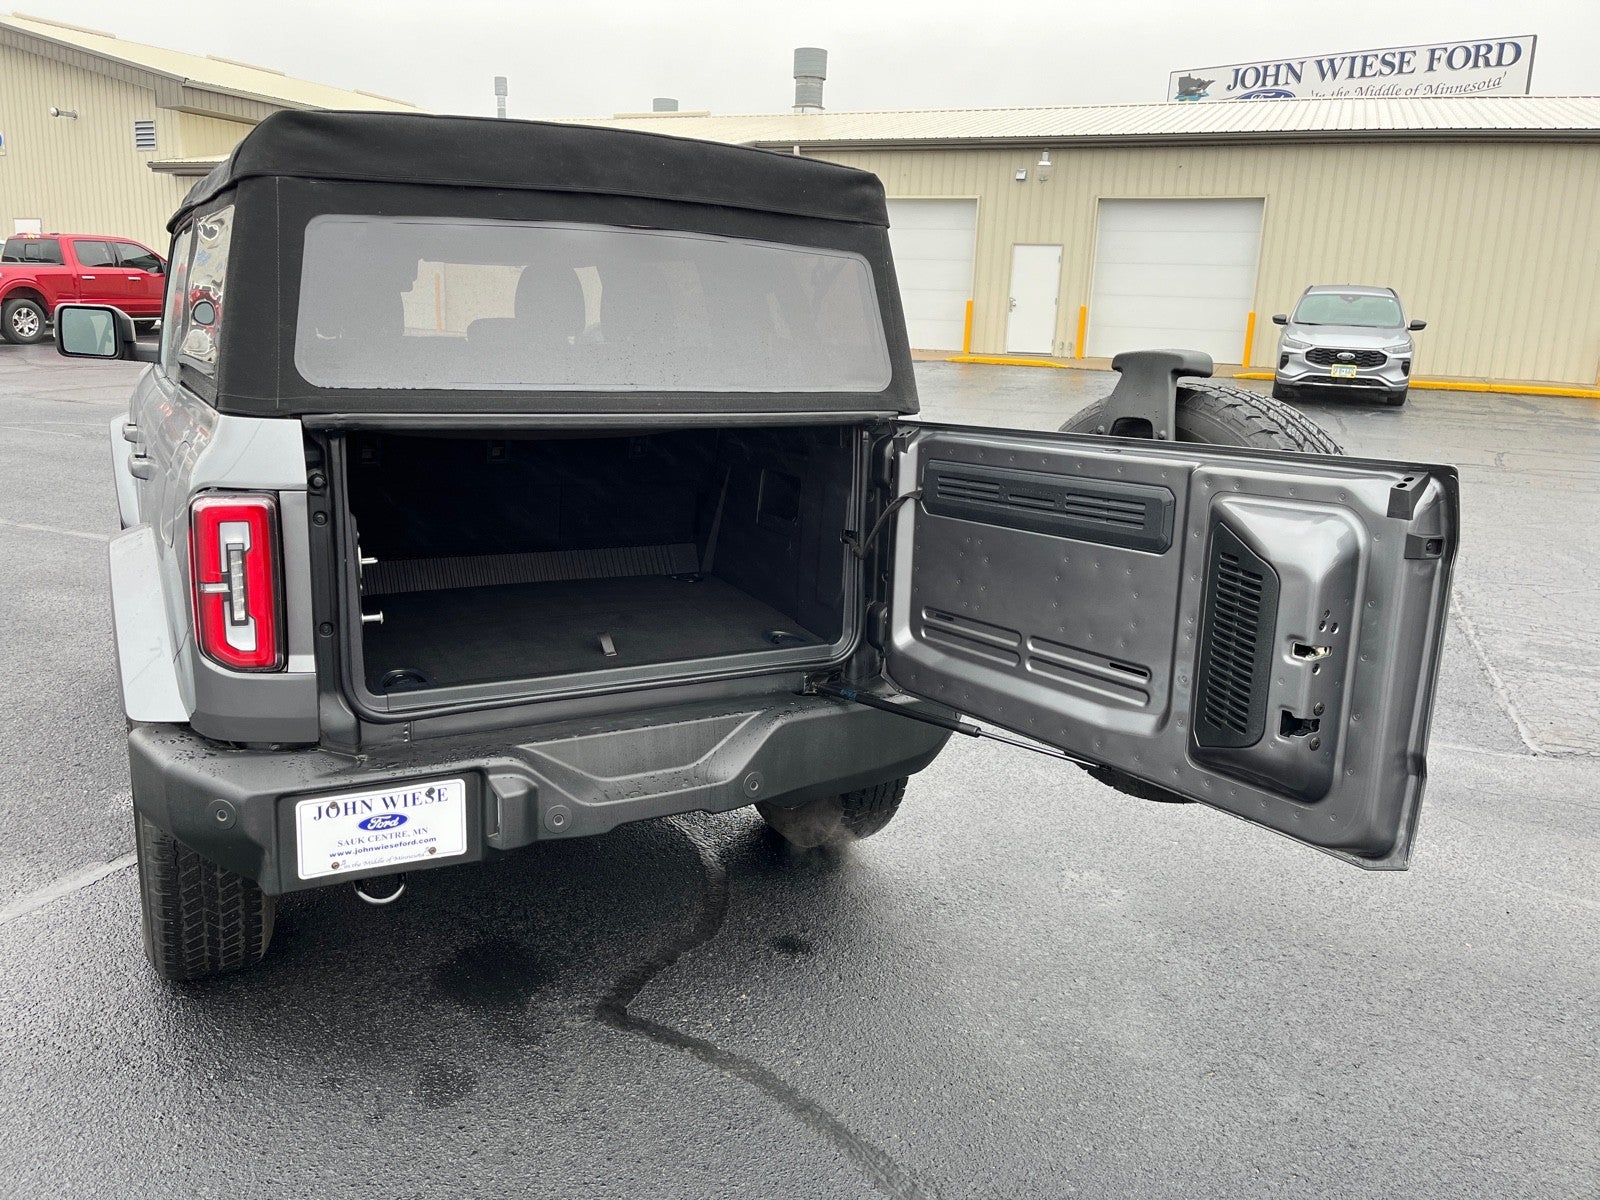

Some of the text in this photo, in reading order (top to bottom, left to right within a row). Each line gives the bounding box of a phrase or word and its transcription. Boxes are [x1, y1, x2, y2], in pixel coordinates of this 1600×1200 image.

[1226, 40, 1522, 91] JOHN WIESE FORD
[313, 787, 449, 821] JOHN WIESE
[366, 815, 400, 830] Ford
[329, 836, 437, 858] www.johnwieseford.com
[337, 827, 429, 848] SAUK CENTRE, MN
